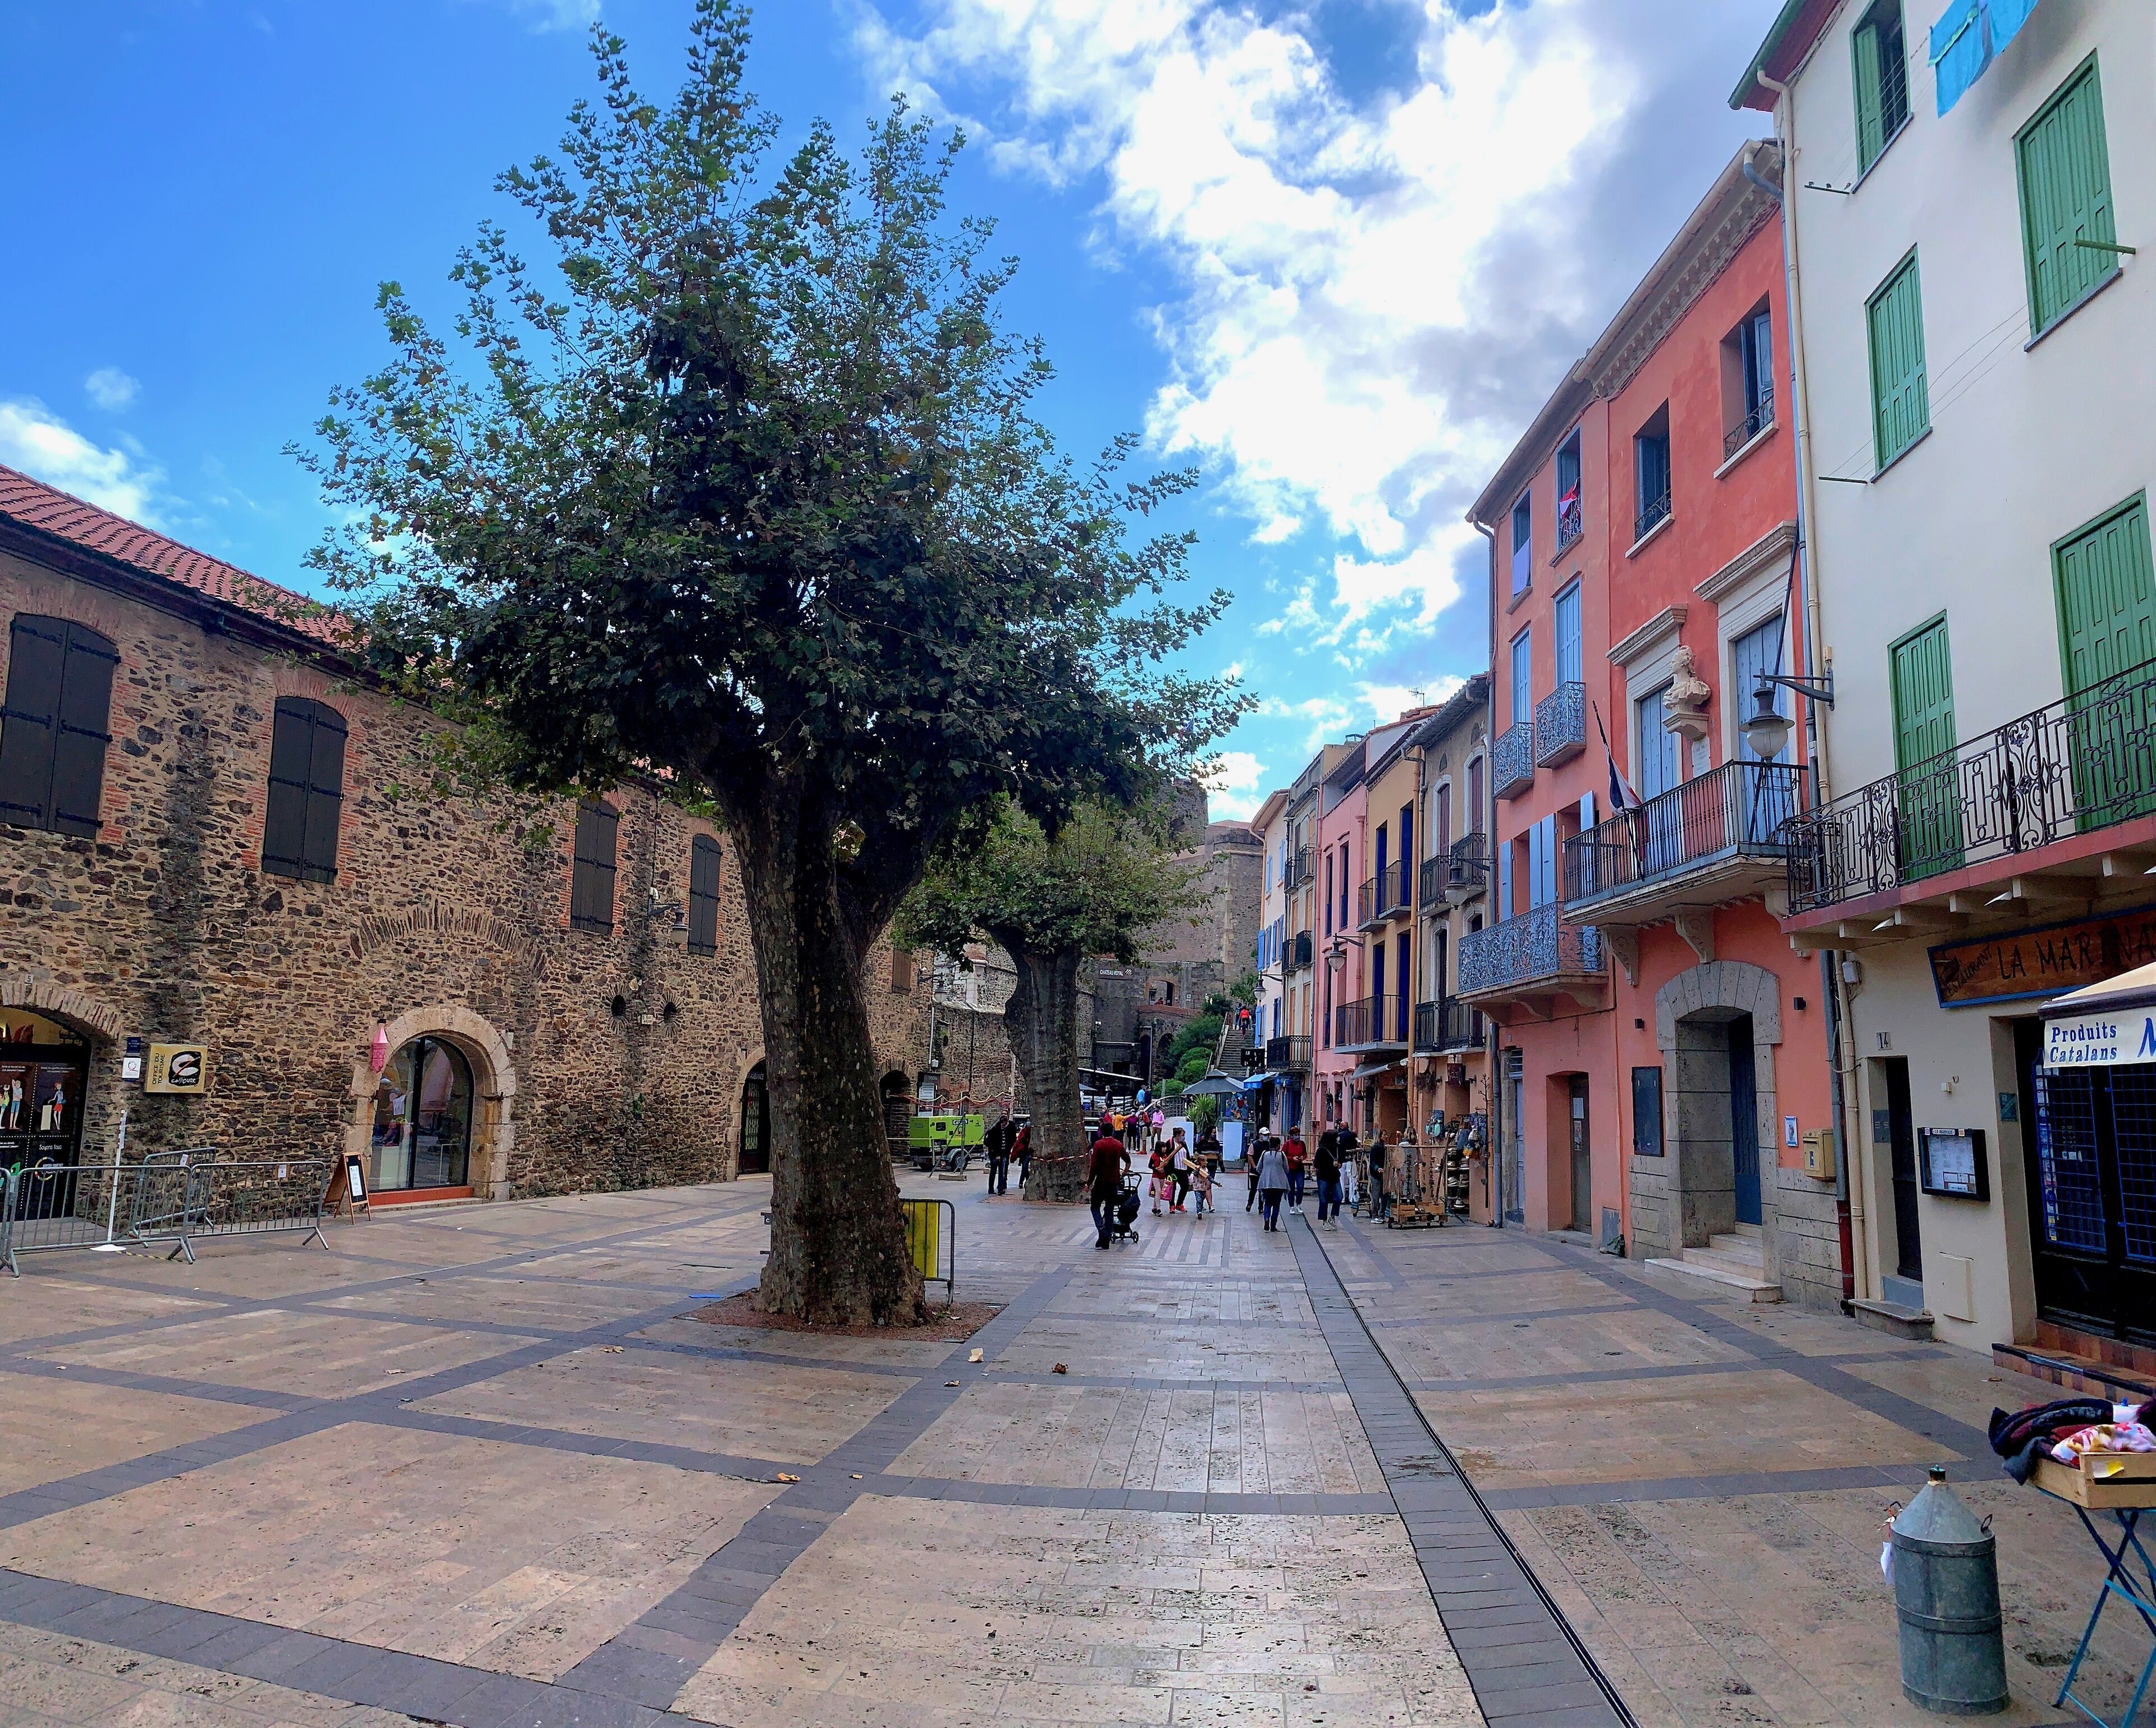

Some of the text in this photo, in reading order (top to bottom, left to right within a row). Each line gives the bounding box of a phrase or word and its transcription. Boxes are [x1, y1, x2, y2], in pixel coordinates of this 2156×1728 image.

[1996, 921, 2156, 981] LA MARINA
[1879, 1031, 1889, 1049] 14
[2051, 1021, 2117, 1043] Produits
[154, 1053, 160, 1062] DU
[2050, 1044, 2118, 1063] Catalans
